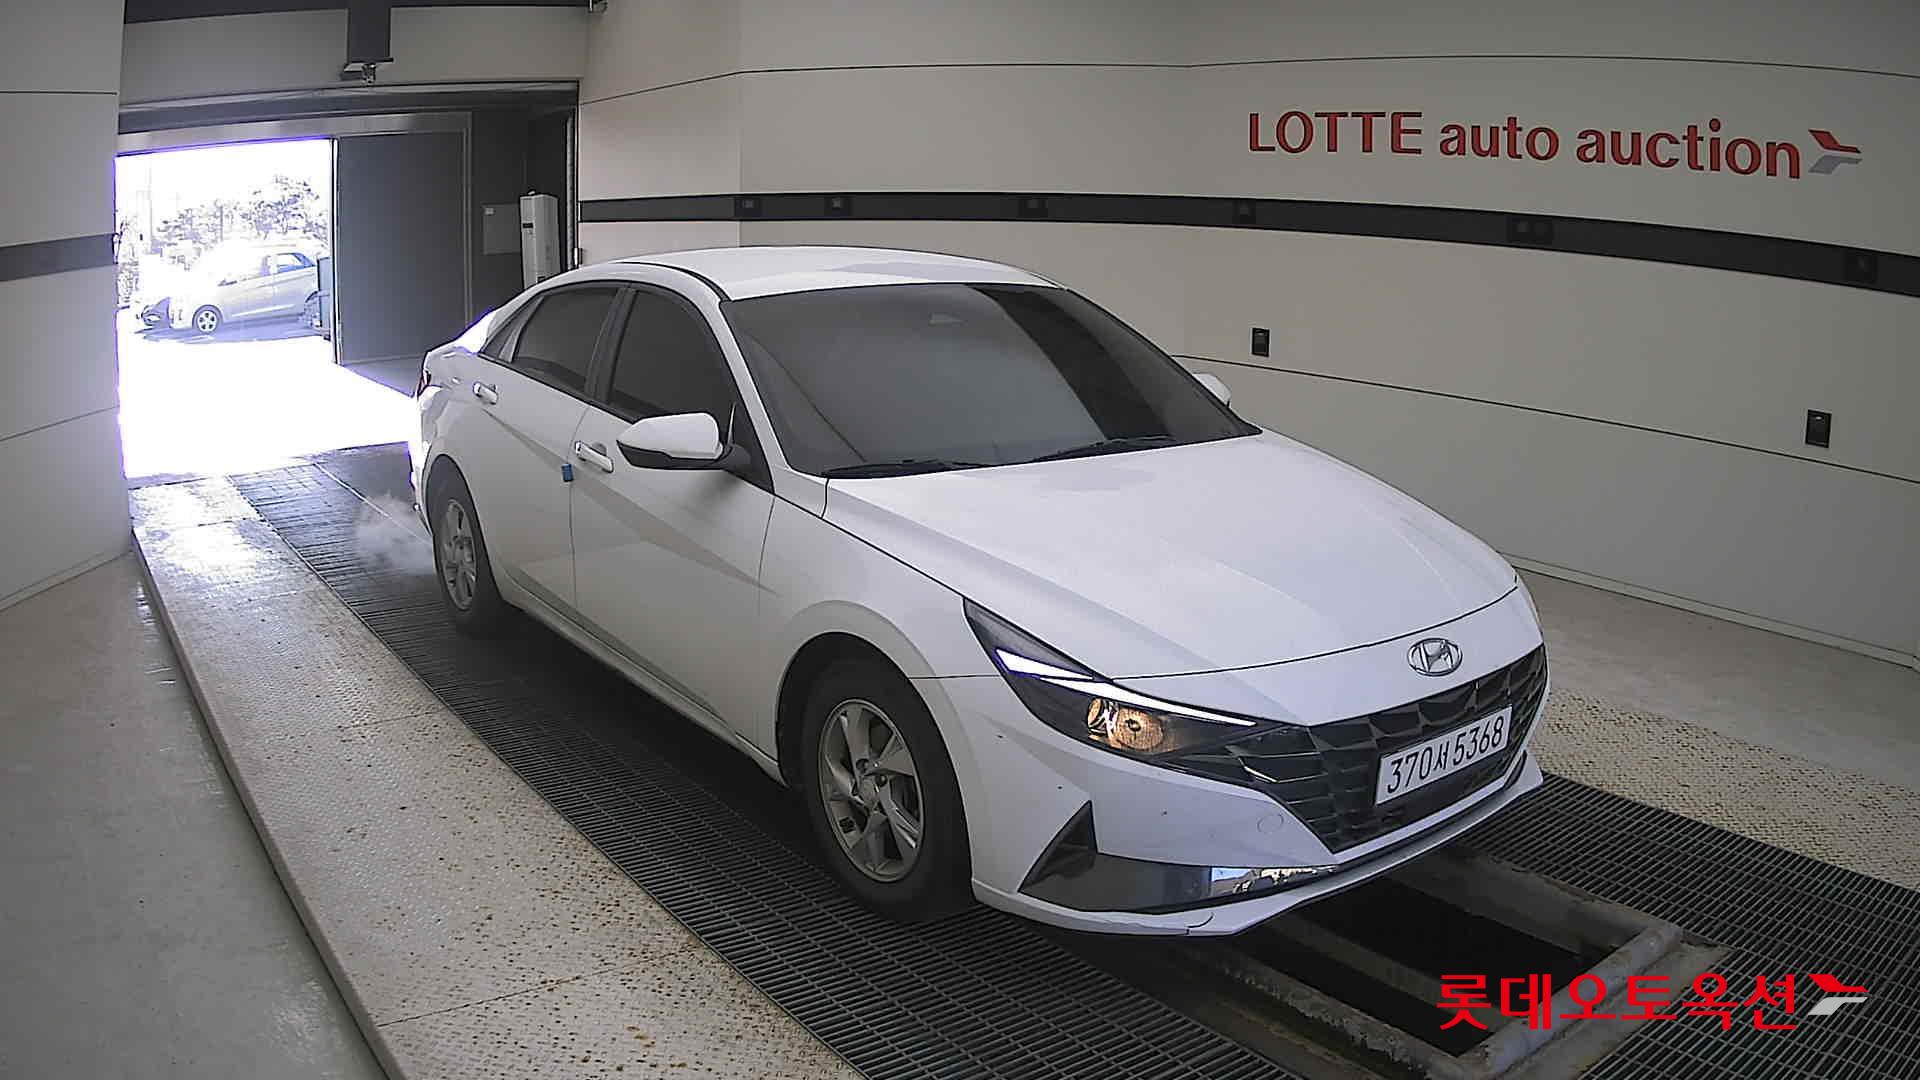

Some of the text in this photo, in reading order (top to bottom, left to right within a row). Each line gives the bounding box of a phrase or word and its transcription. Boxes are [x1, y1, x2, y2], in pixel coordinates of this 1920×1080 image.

[1248, 111, 1802, 179] LOTTE auto auction
